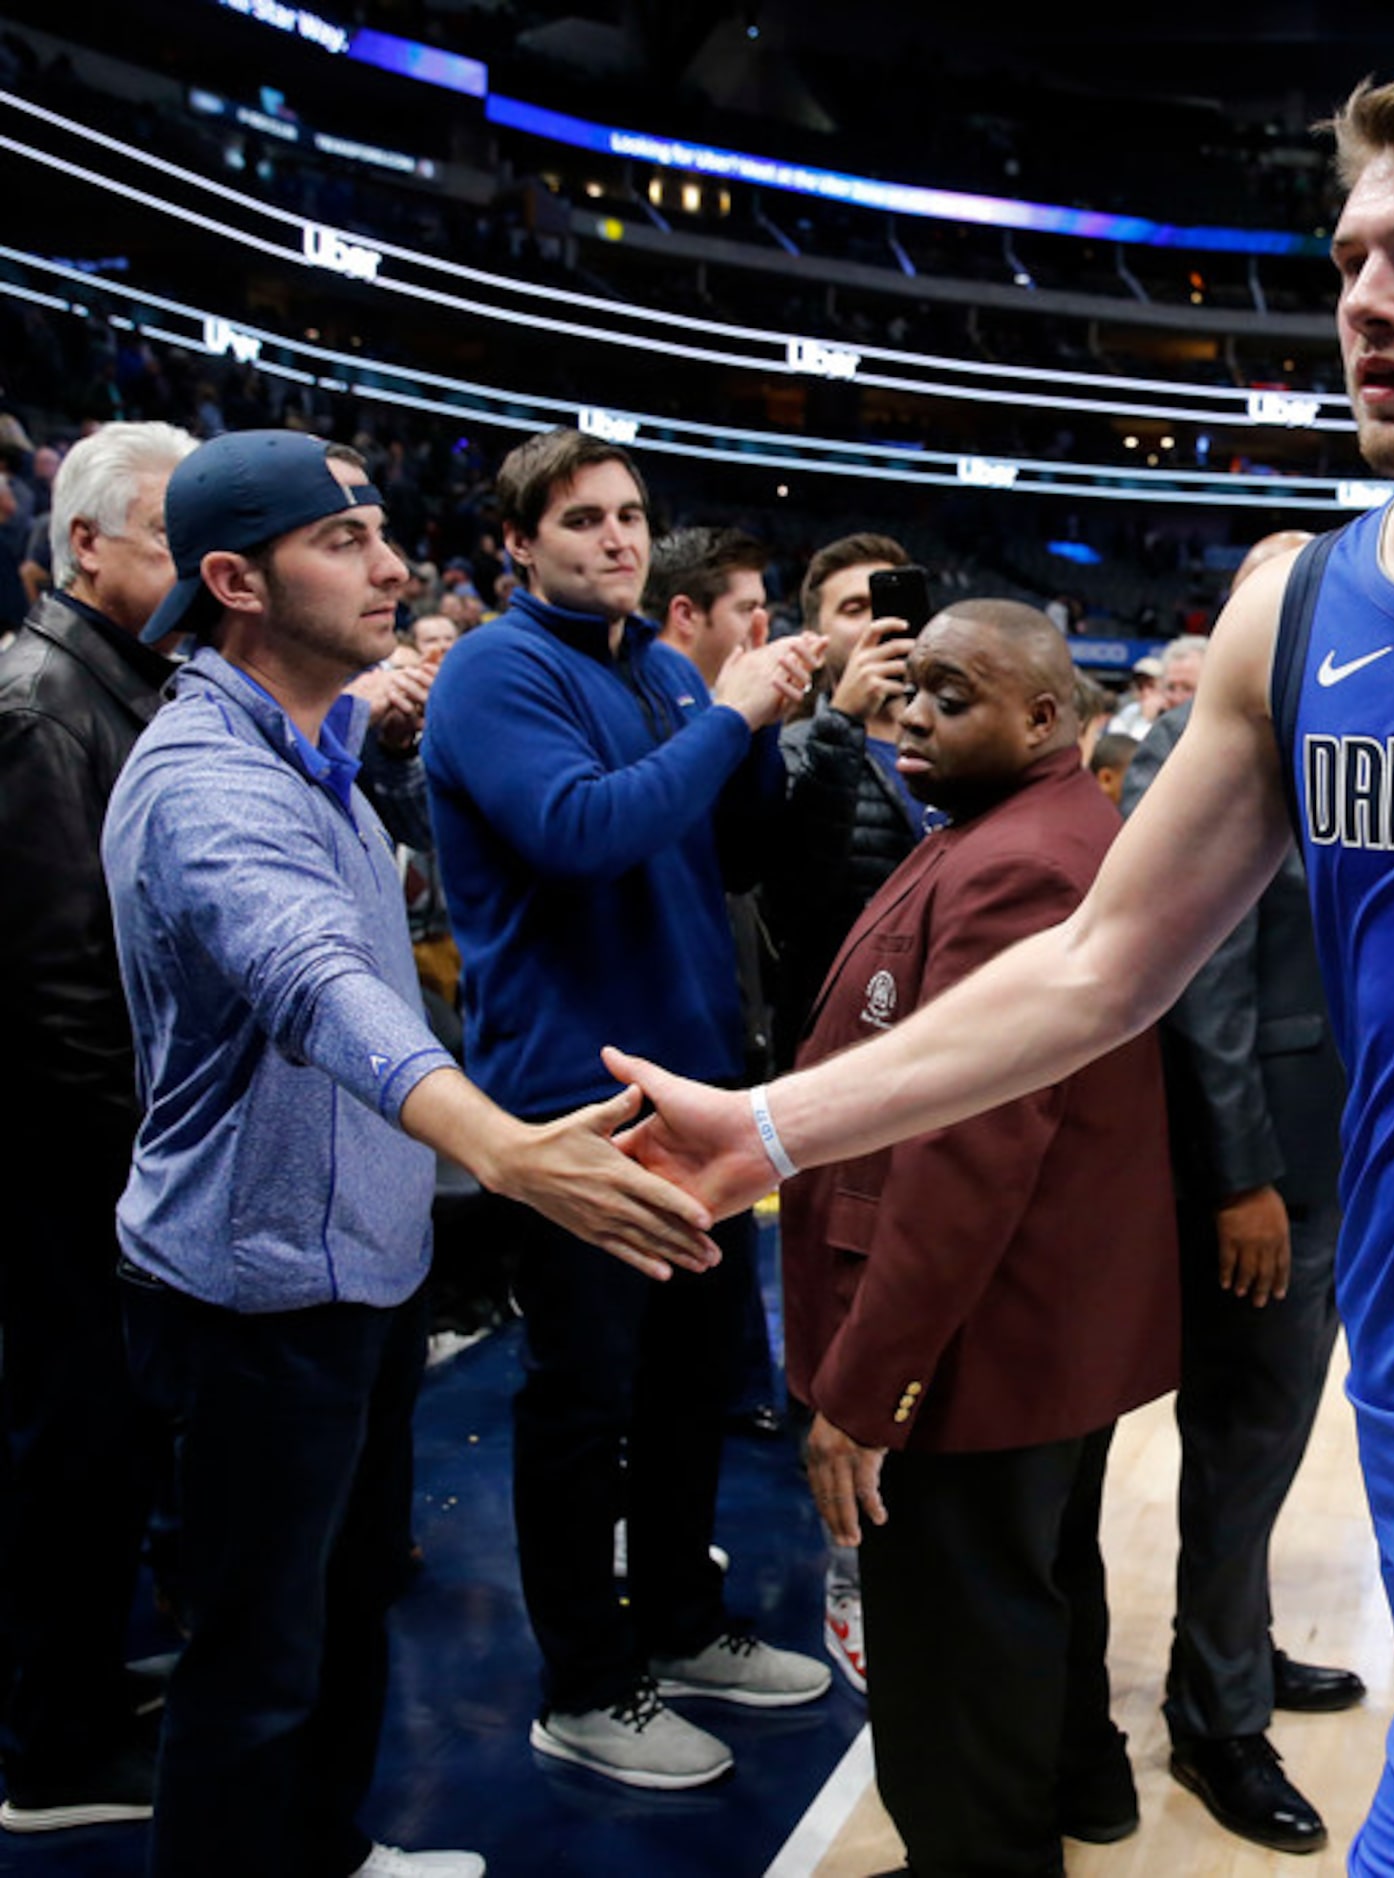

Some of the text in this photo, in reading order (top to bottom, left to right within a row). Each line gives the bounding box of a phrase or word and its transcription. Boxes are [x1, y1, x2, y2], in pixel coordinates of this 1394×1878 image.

[304, 223, 380, 280] Uber
[788, 338, 859, 379] Uber
[579, 408, 638, 443] Uber
[1249, 391, 1319, 426] Uber
[958, 456, 1018, 488] Uber
